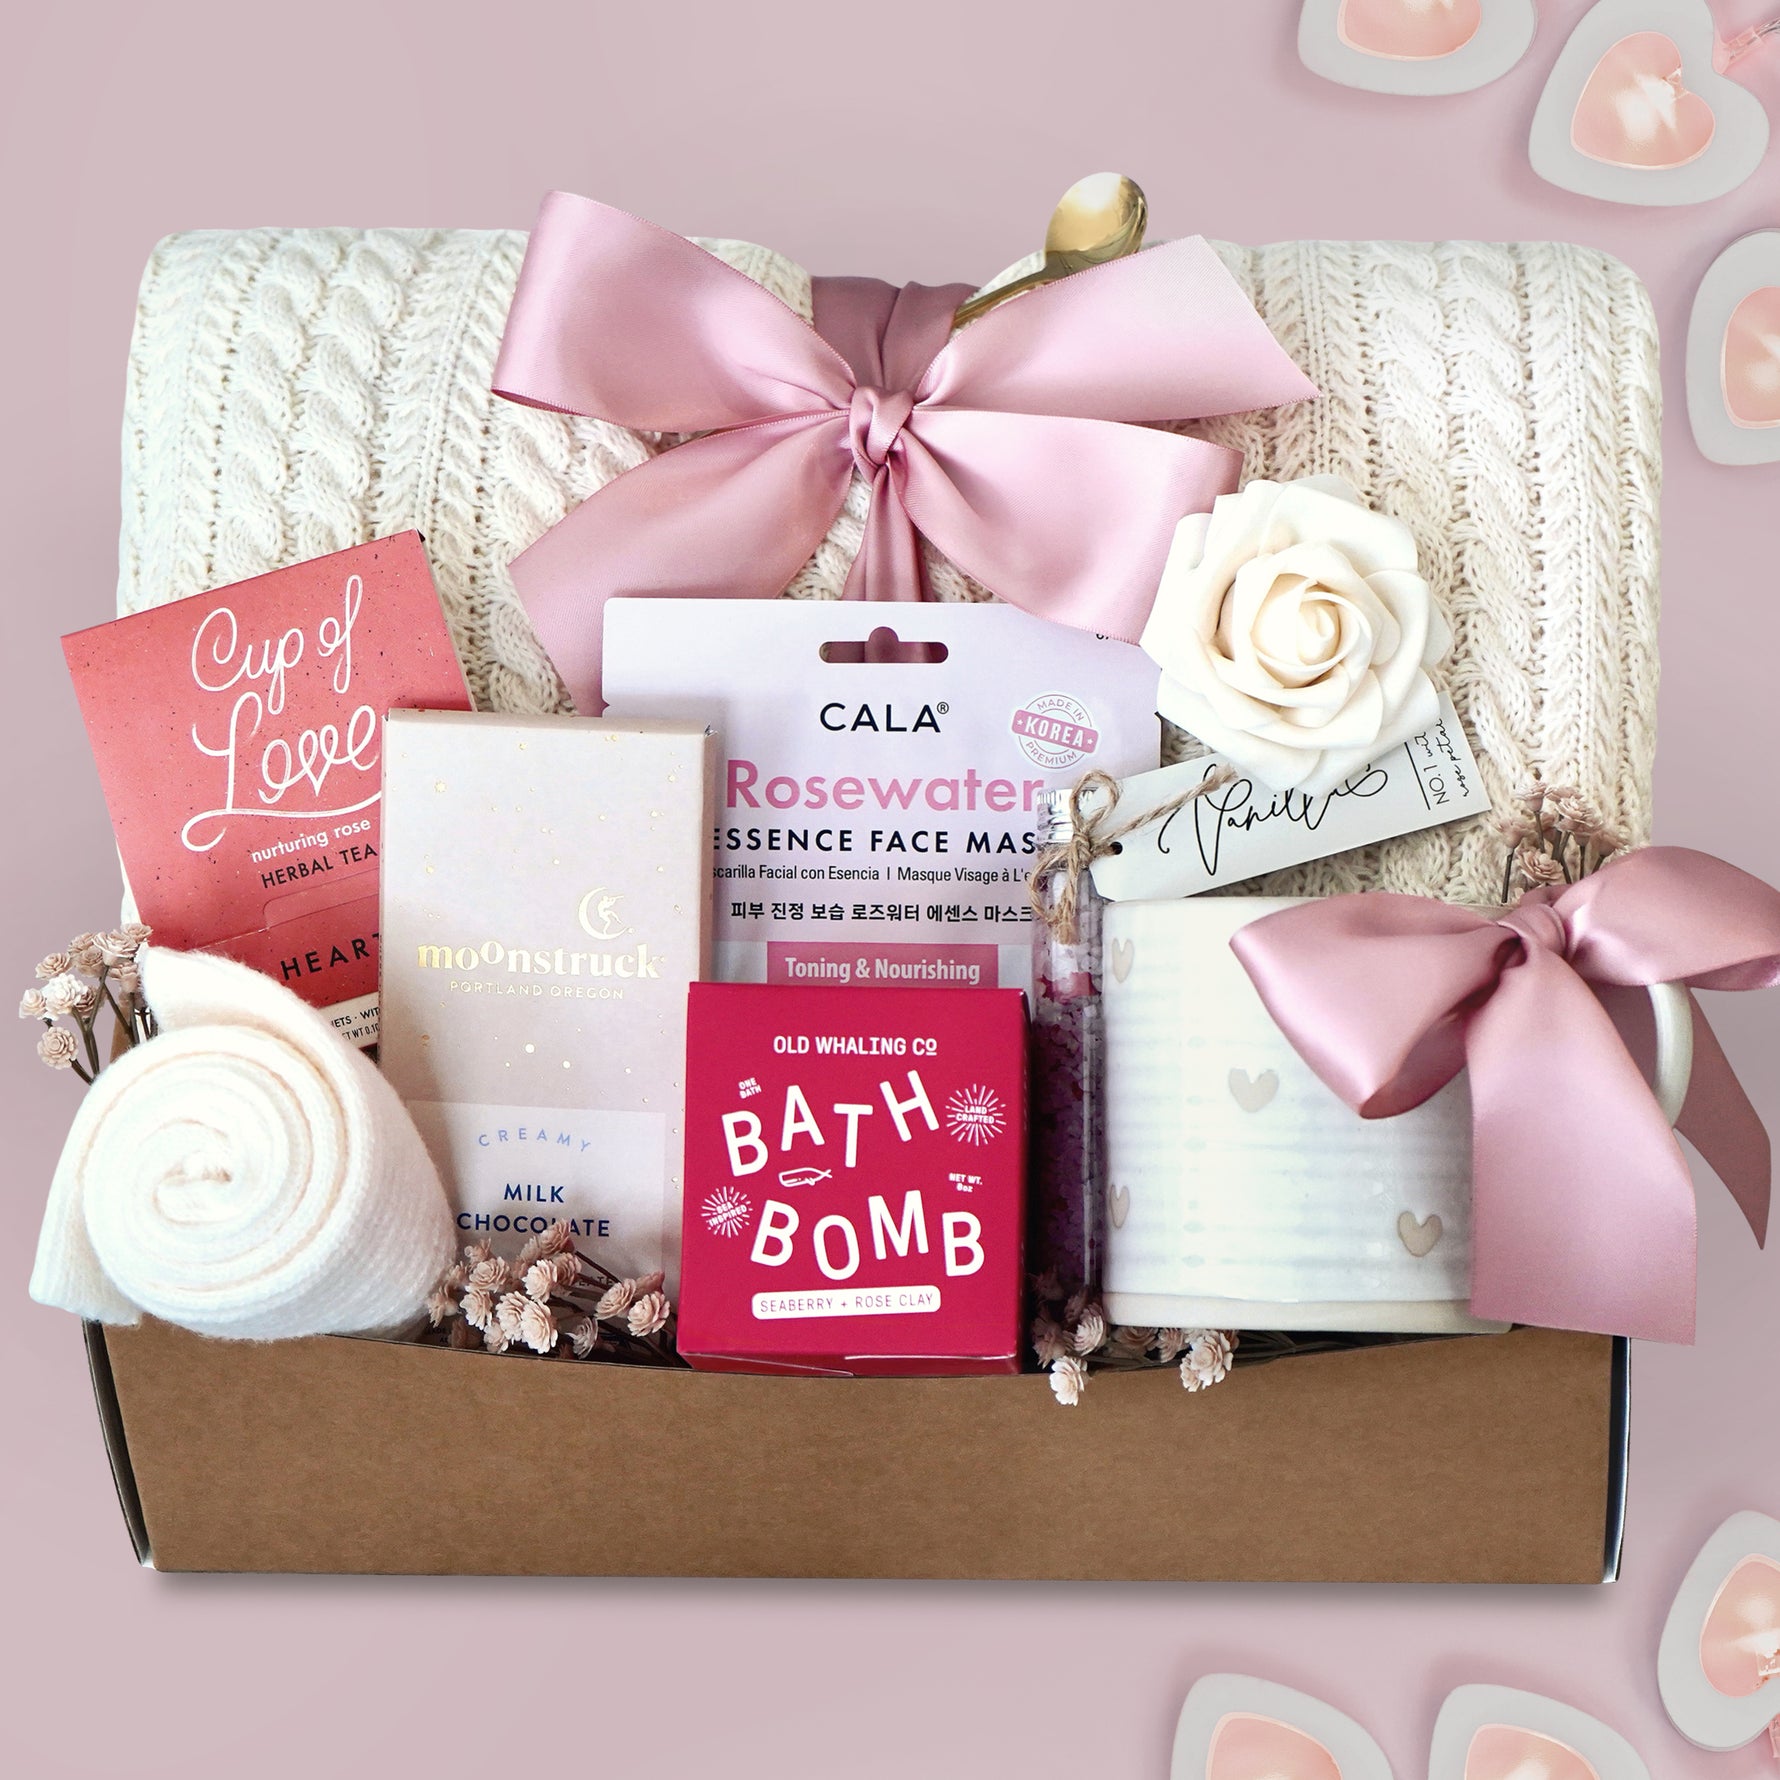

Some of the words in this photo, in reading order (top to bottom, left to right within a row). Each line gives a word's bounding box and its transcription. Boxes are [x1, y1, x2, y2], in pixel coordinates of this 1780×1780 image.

[191, 606, 304, 715] Cup
[317, 574, 363, 694] of
[1036, 698, 1073, 711] MADE
[1073, 708, 1085, 721] IN
[1024, 716, 1085, 748] KOREA
[1025, 741, 1078, 766] PREMIUM
[182, 692, 381, 852] Love
[725, 759, 1045, 812] Rosewater
[250, 830, 329, 863] nurturing
[334, 818, 371, 838] rose
[870, 830, 949, 853] FACE
[966, 831, 1036, 855] MAS
[261, 855, 334, 889] HERBAL
[339, 843, 378, 866] TEA
[759, 864, 797, 880] Facial
[800, 868, 825, 880] con
[828, 865, 880, 881] Esencia
[897, 866, 952, 884] Masque
[954, 867, 999, 885] Visage
[1002, 868, 1010, 882] à
[730, 901, 765, 920] 피부
[771, 901, 804, 921] 진정
[811, 902, 845, 921] 보습
[851, 903, 920, 922] 로즈워터
[926, 904, 979, 923] 에센스
[416, 940, 661, 979] moonstruck
[784, 957, 851, 984] Toning
[855, 957, 870, 979] &
[875, 958, 980, 985] Nourishing
[449, 980, 543, 997] PORTLAND
[550, 985, 624, 1000] OREGON
[773, 1035, 810, 1055] OLD
[815, 1036, 907, 1056] WHALING
[738, 1077, 757, 1090] ONE
[955, 1113, 995, 1124] CRAFTED
[964, 1105, 988, 1115] LAND
[721, 1069, 940, 1177] BATH
[478, 1127, 592, 1152] CREAMY
[948, 1172, 967, 1183] NET
[503, 1183, 565, 1204] MILK
[708, 1204, 747, 1227] INSPIRED
[716, 1201, 734, 1214] SEA
[456, 1212, 610, 1238] CHOCOATE
[750, 1189, 985, 1281] BOMB
[760, 1297, 834, 1313] SEABERRY
[855, 1294, 892, 1308] ROSE
[899, 1293, 933, 1307] CLAY
